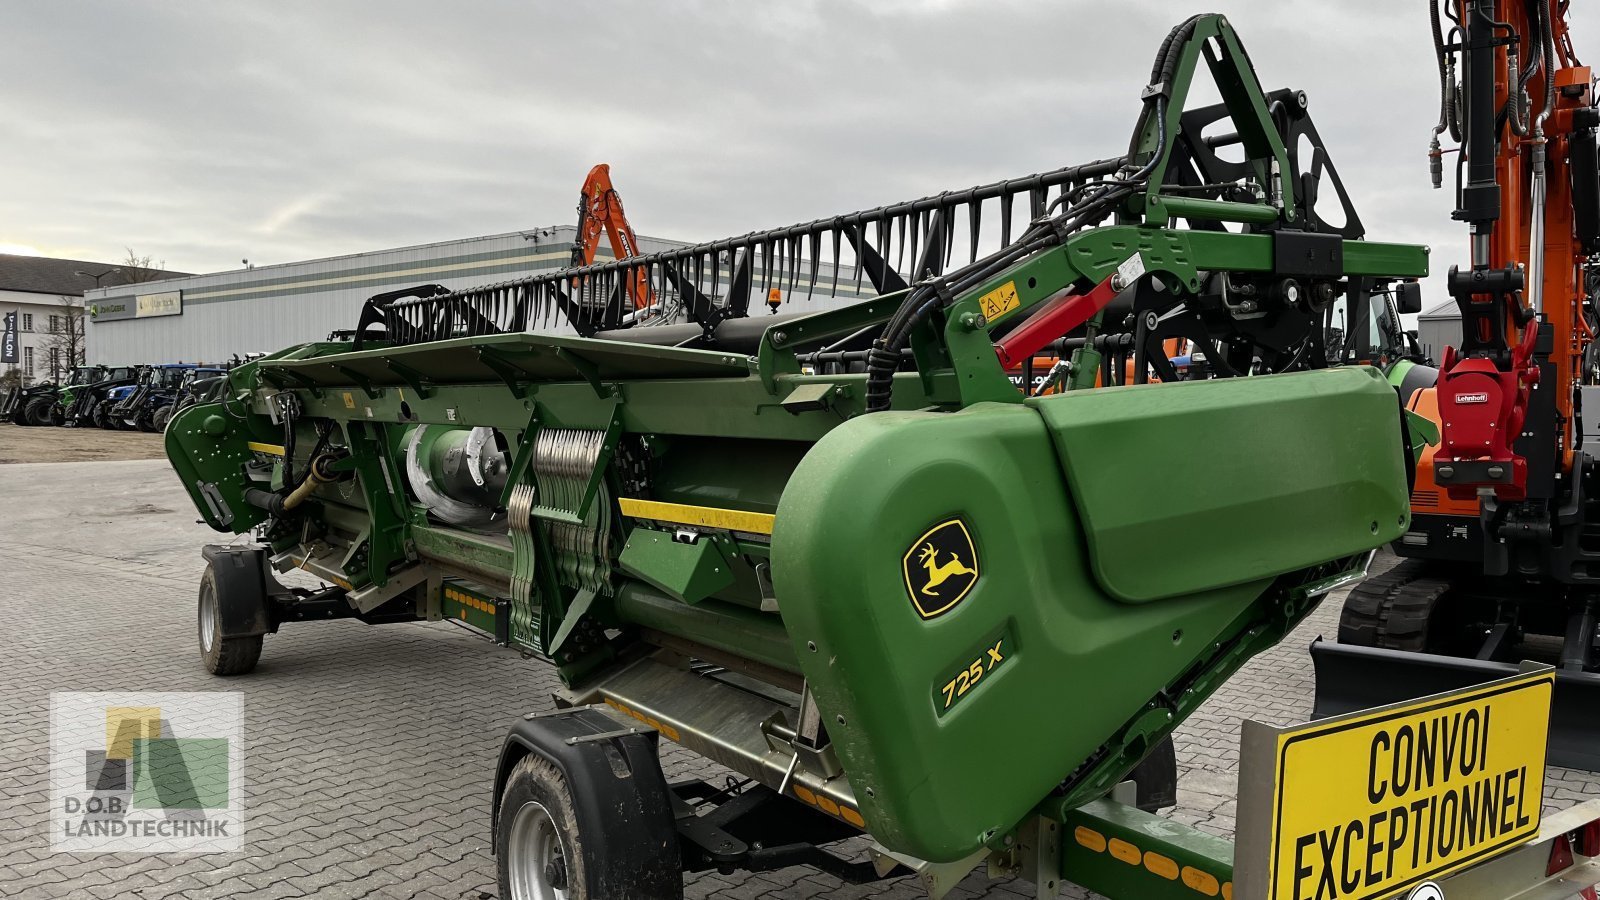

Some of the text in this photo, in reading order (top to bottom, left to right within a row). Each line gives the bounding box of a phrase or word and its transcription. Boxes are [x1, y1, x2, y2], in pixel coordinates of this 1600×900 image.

[1457, 394, 1486, 402] Lehnhoff
[941, 639, 1005, 711] 725 X
[1367, 705, 1491, 805] CONVOI
[1292, 766, 1531, 900] EXCEPTIONNEL
